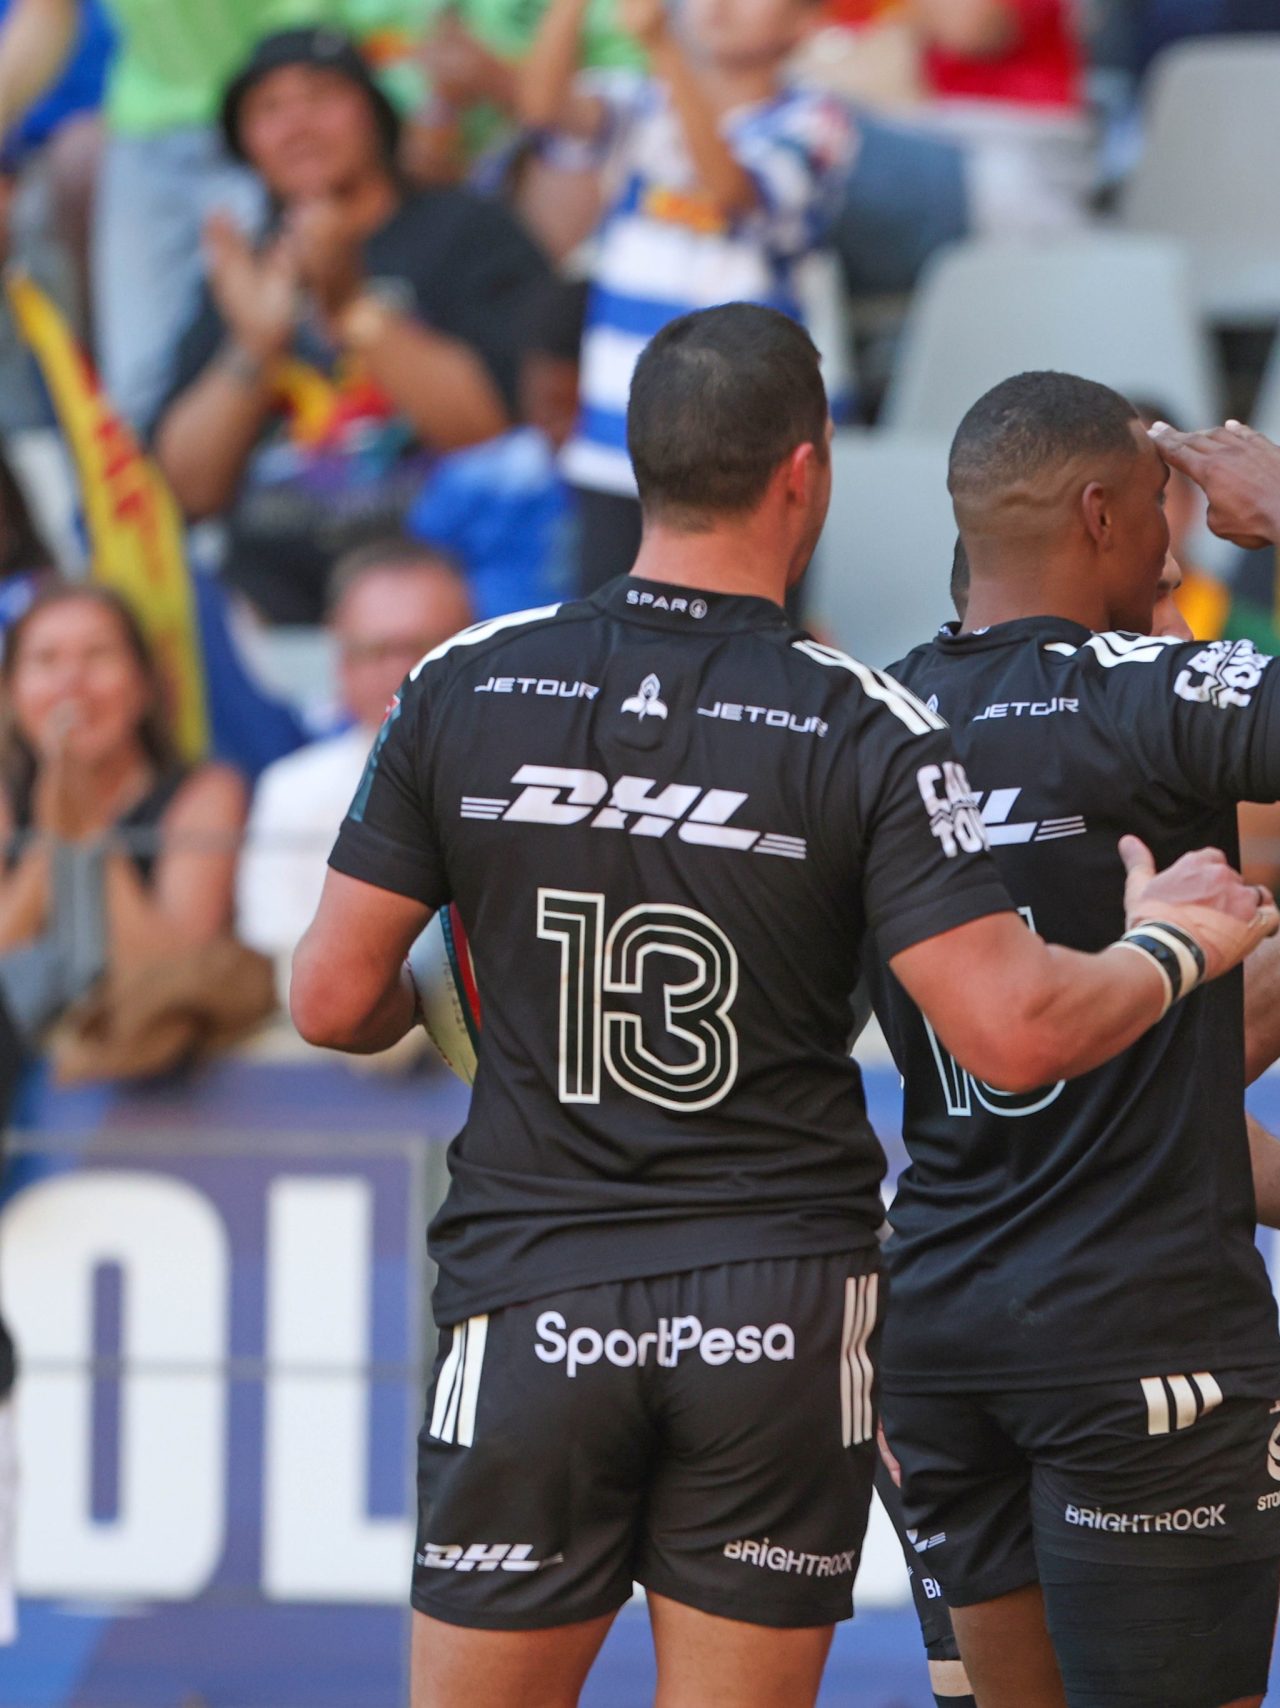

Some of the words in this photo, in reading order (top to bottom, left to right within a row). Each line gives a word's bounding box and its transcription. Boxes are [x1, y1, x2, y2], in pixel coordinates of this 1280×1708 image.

[626, 590, 688, 613] SPAR
[474, 677, 600, 699] JETOUR
[697, 702, 829, 737] JETOUR
[502, 764, 761, 851] DHL
[536, 887, 738, 1112] 13
[534, 1311, 796, 1378] SportPesa
[423, 1542, 541, 1572] DHL
